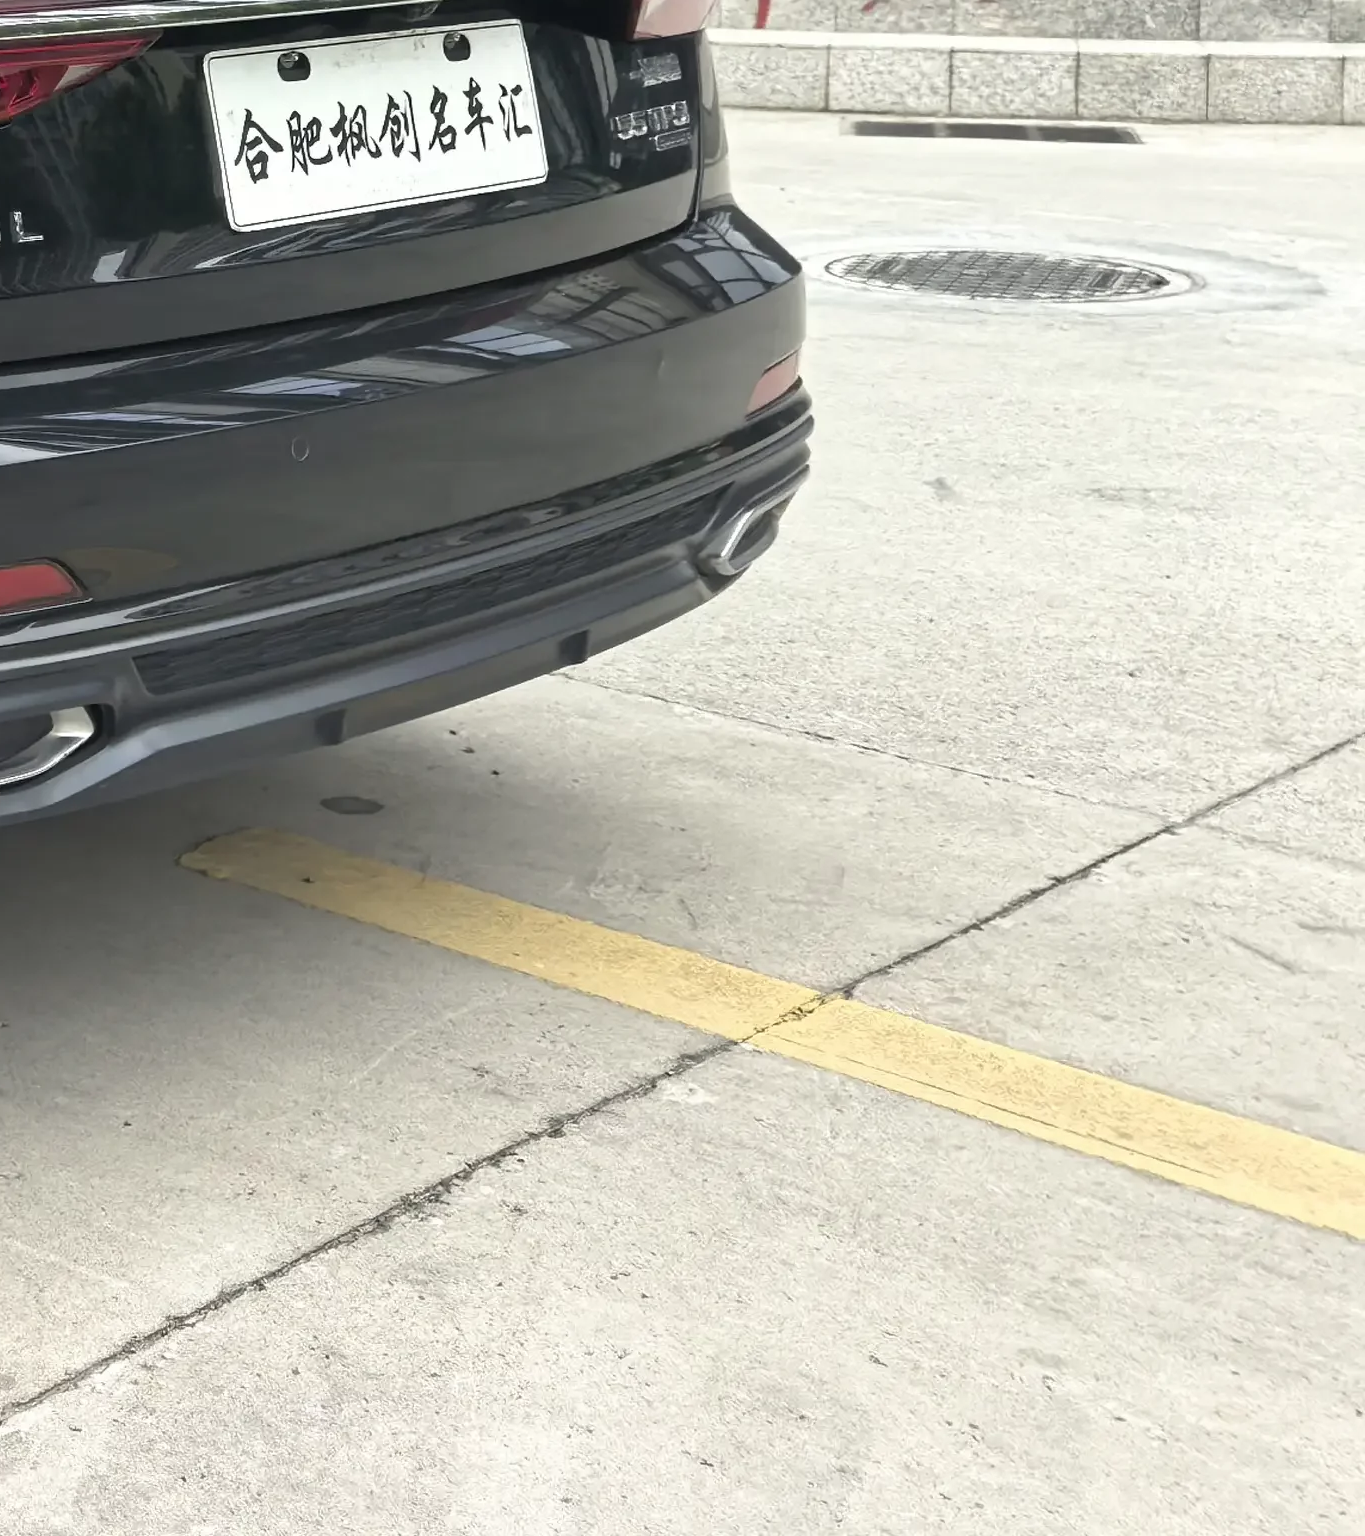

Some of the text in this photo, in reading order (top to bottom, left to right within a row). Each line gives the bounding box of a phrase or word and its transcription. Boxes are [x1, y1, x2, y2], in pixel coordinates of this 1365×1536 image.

[234, 77, 534, 185] 合肥枫创名车汇
